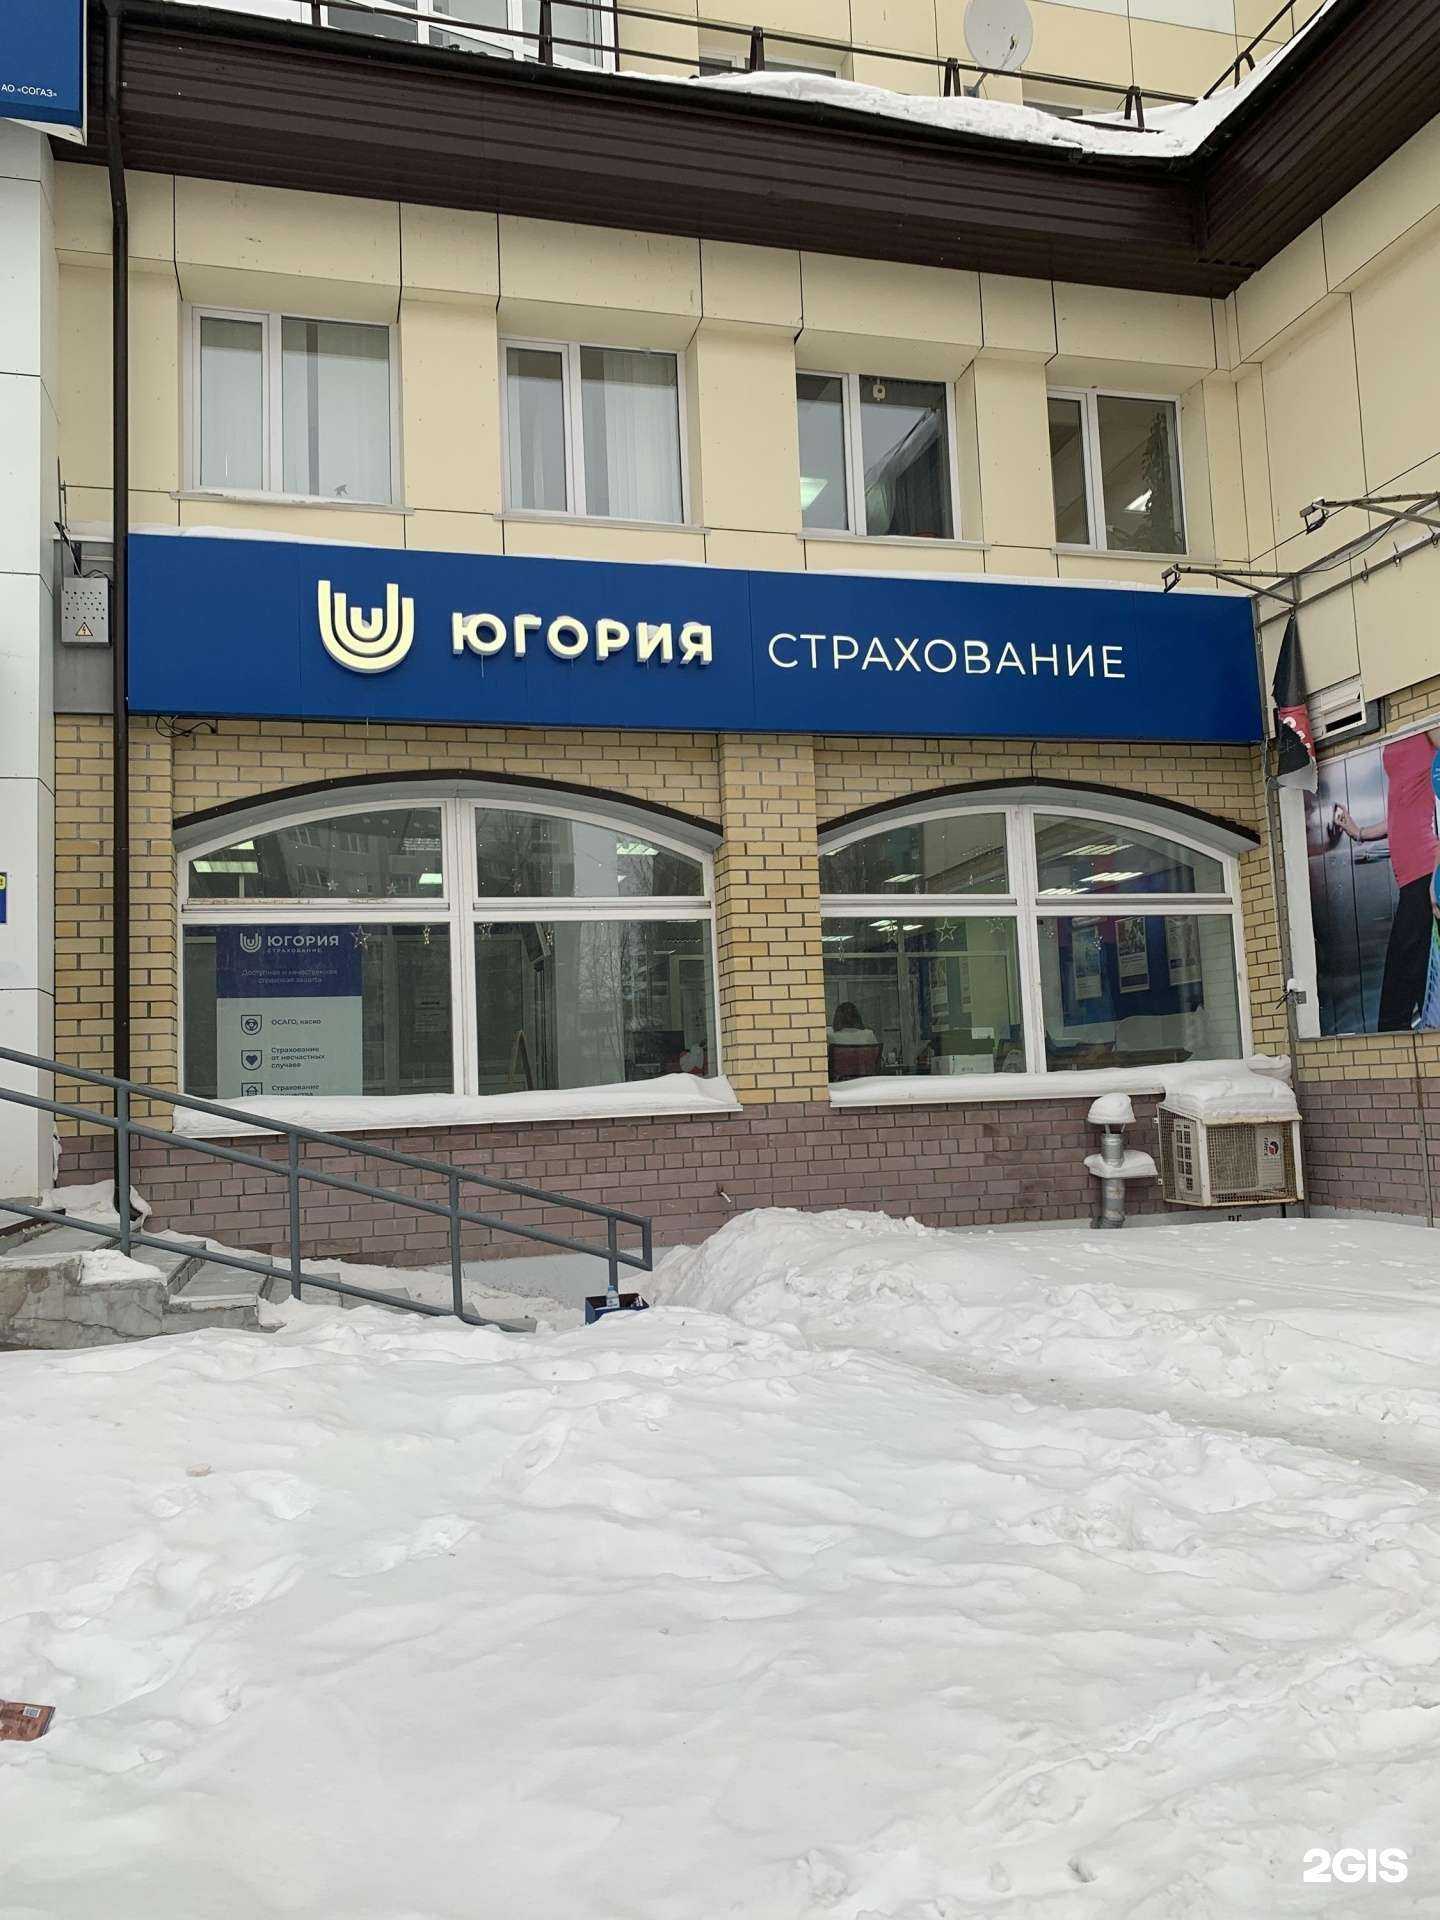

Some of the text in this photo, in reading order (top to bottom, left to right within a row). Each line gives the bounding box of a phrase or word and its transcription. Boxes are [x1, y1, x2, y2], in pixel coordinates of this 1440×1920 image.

[1, 84, 15, 93] АО
[451, 611, 1126, 679] ЮГОРИЯ СТРАХОВАНИЕ
[267, 935, 339, 947] ЮГОРИЯ
[271, 1047, 320, 1055] Страхование
[271, 1084, 320, 1093] Страхование
